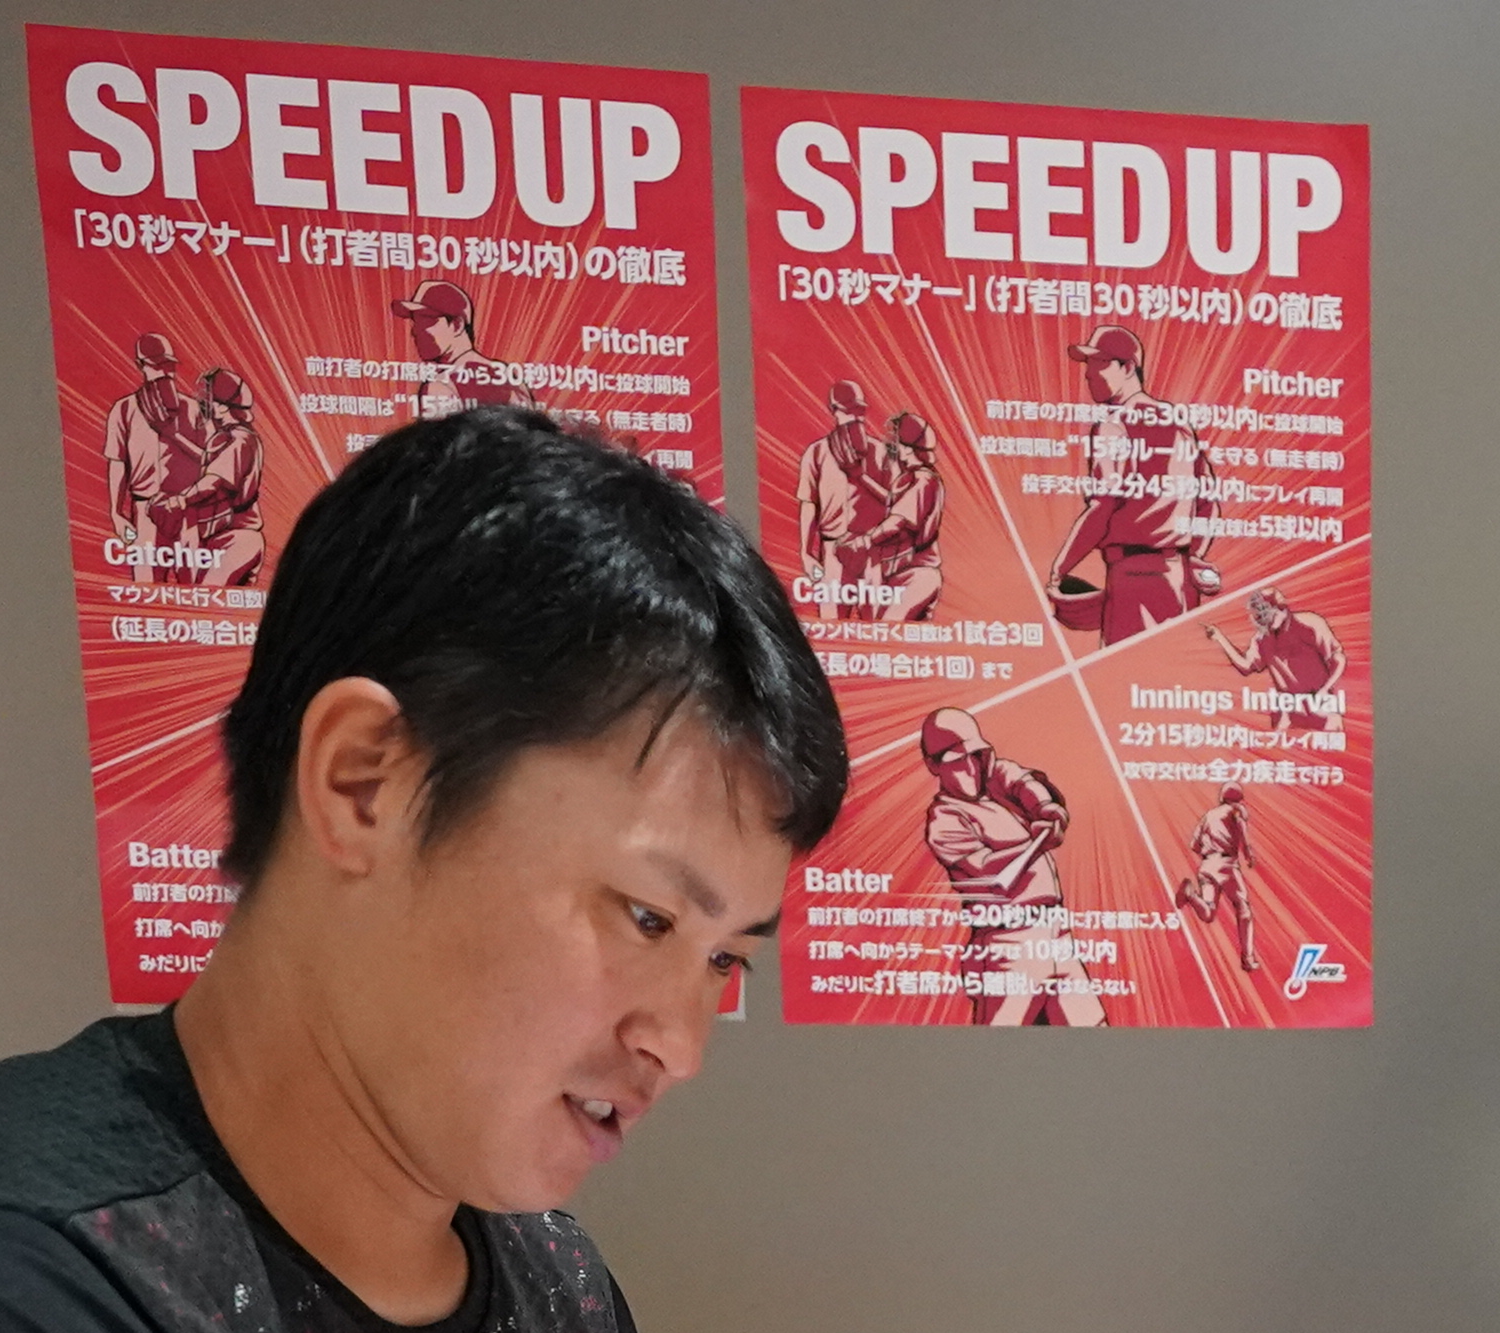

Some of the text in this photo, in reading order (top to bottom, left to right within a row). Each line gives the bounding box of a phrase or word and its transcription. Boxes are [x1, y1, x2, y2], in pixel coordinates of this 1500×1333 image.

[65, 62, 682, 229] SPEED UP
[775, 120, 1343, 277] SPEED UP
[582, 325, 689, 357] Pitcher
[306, 355, 691, 396] 前打者の打席終了から30秒以内に投球開始
[1243, 368, 1344, 399] Pitcher
[104, 538, 226, 569] Catcher
[107, 585, 269, 608] マウンドに行く回数
[793, 577, 906, 606] Catcher
[1130, 683, 1346, 716] Innings Interval
[1119, 722, 1346, 752] 2分15秒以内にプレイ再開
[128, 842, 224, 869] Batter
[805, 867, 893, 894] Batter
[139, 949, 213, 973] みだりに
[1309, 966, 1340, 977] NPB
